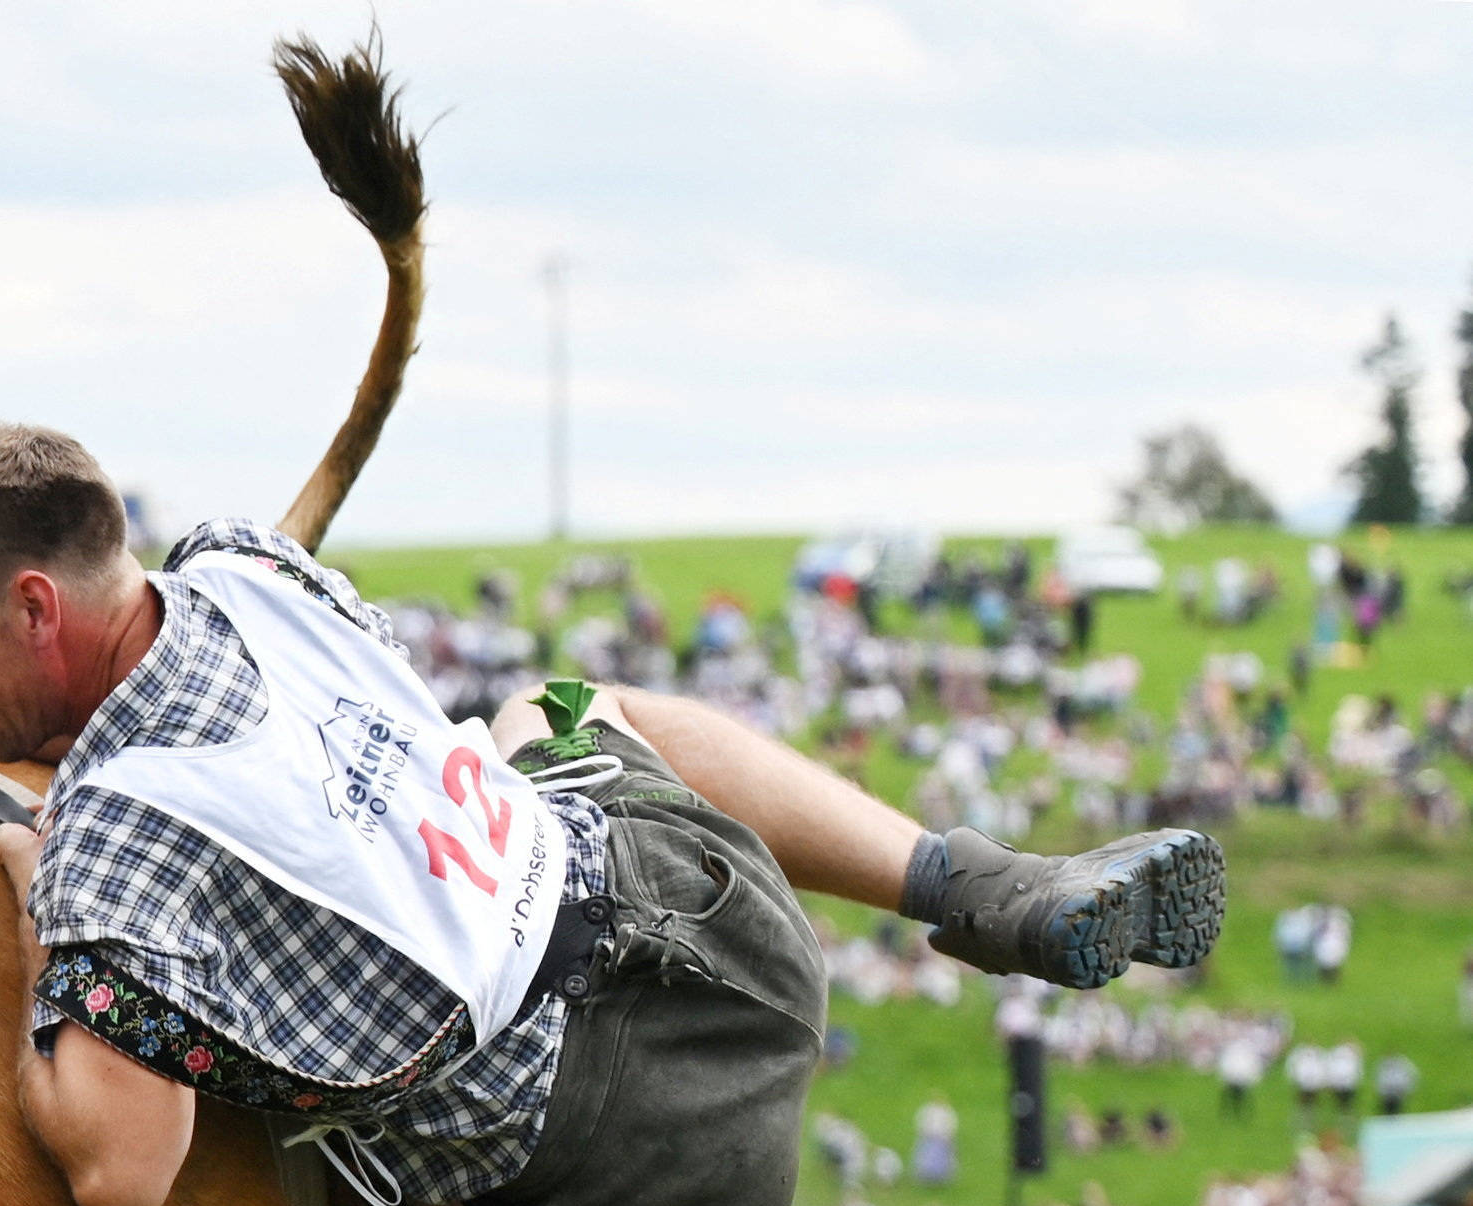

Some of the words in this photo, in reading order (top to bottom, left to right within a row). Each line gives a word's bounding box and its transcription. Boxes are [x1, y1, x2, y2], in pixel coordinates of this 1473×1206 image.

[340, 708, 395, 822] Leitner
[361, 723, 417, 833] WOHNBAU
[418, 747, 511, 896] 12
